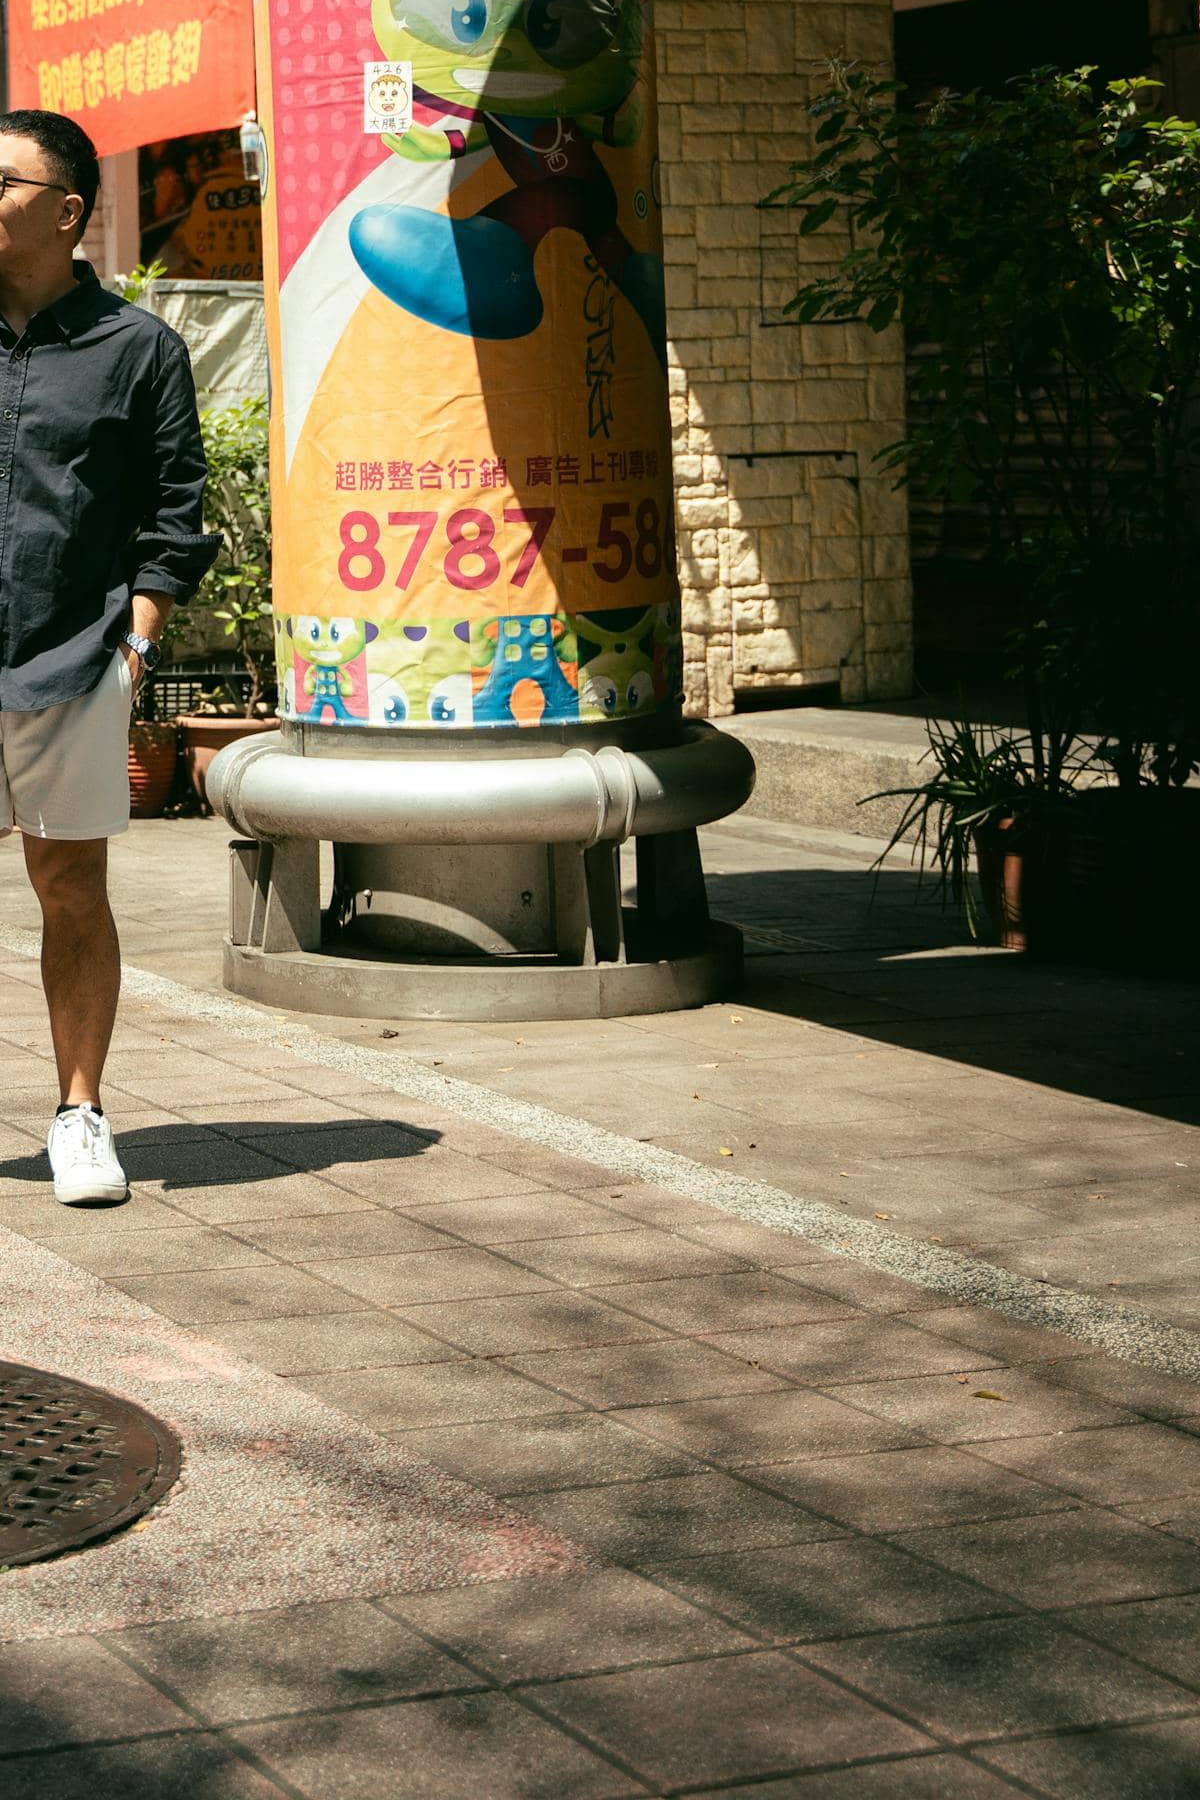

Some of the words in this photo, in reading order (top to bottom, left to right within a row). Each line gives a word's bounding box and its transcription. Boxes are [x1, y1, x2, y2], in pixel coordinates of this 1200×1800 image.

[373, 64, 402, 75] 426
[334, 460, 508, 491] 超勝整合行銷
[337, 496, 677, 592] 8787-58
